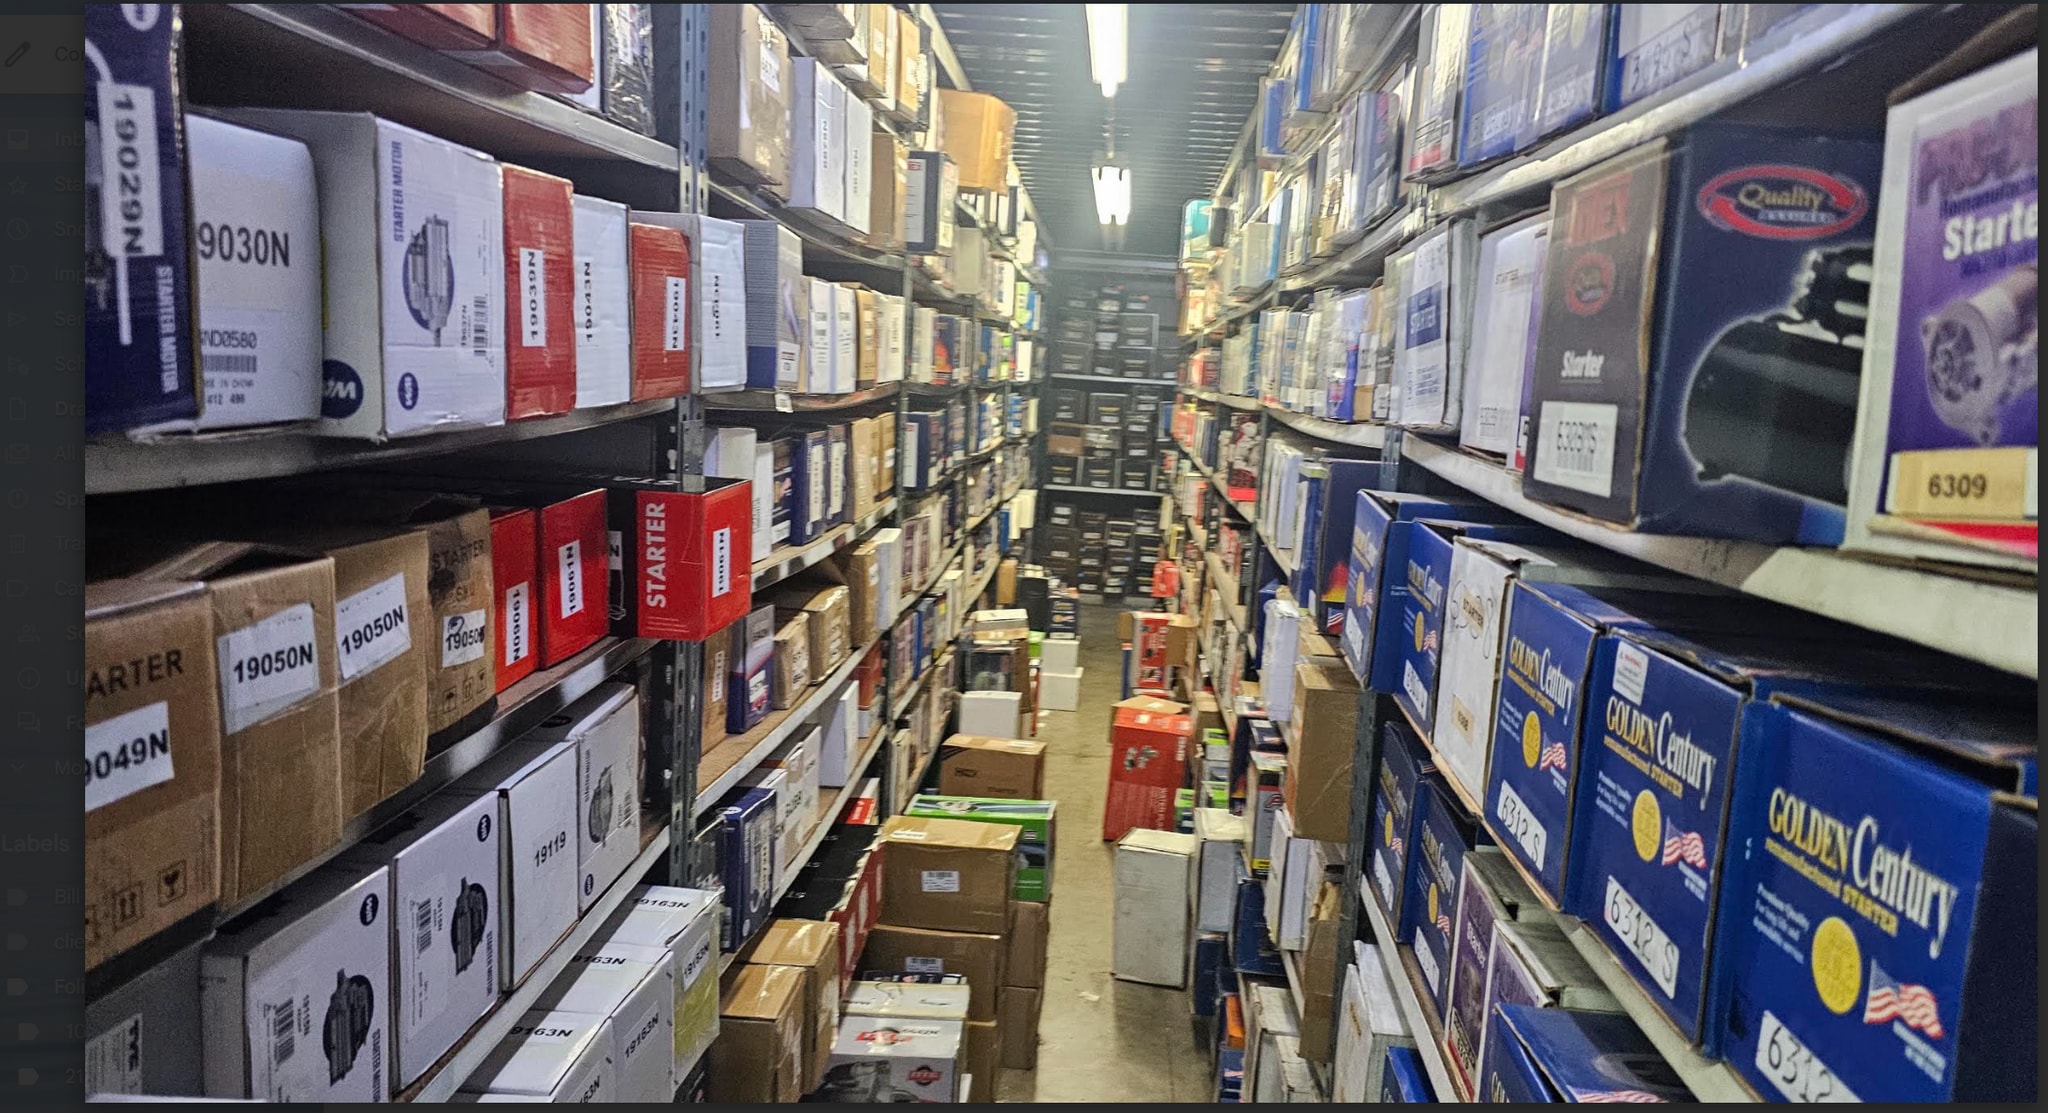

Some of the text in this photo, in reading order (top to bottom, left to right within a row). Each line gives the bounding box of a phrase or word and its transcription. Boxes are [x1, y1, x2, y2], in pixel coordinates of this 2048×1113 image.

[113, 94, 143, 253] 19029N
[391, 140, 404, 243] STARTER MOTOR
[1737, 183, 1825, 212] Quality
[155, 266, 176, 334] STARTER
[528, 251, 538, 340] 19039N
[1560, 350, 1606, 378] Starter
[1927, 474, 1988, 500] 6309
[567, 545, 577, 612] 19061N
[646, 502, 666, 608] STARTER
[341, 604, 405, 656] 19050N
[513, 588, 522, 661] 19060N
[234, 643, 314, 684] 19050N
[1509, 635, 1541, 684] GOLDEN
[1538, 647, 1577, 726] Century
[1606, 694, 1659, 756] GOLDEN
[1656, 711, 1717, 811] Century
[2, 833, 71, 852] Labels
[533, 831, 566, 868] 19119
[1501, 794, 1542, 864] 6312 S
[1768, 787, 1959, 960] GOLDEN Century
[1610, 886, 1676, 982] 6312 S
[1841, 885, 1898, 937] STARTER
[624, 1011, 660, 1060] 19163N
[1768, 1025, 1833, 1102] 6312
